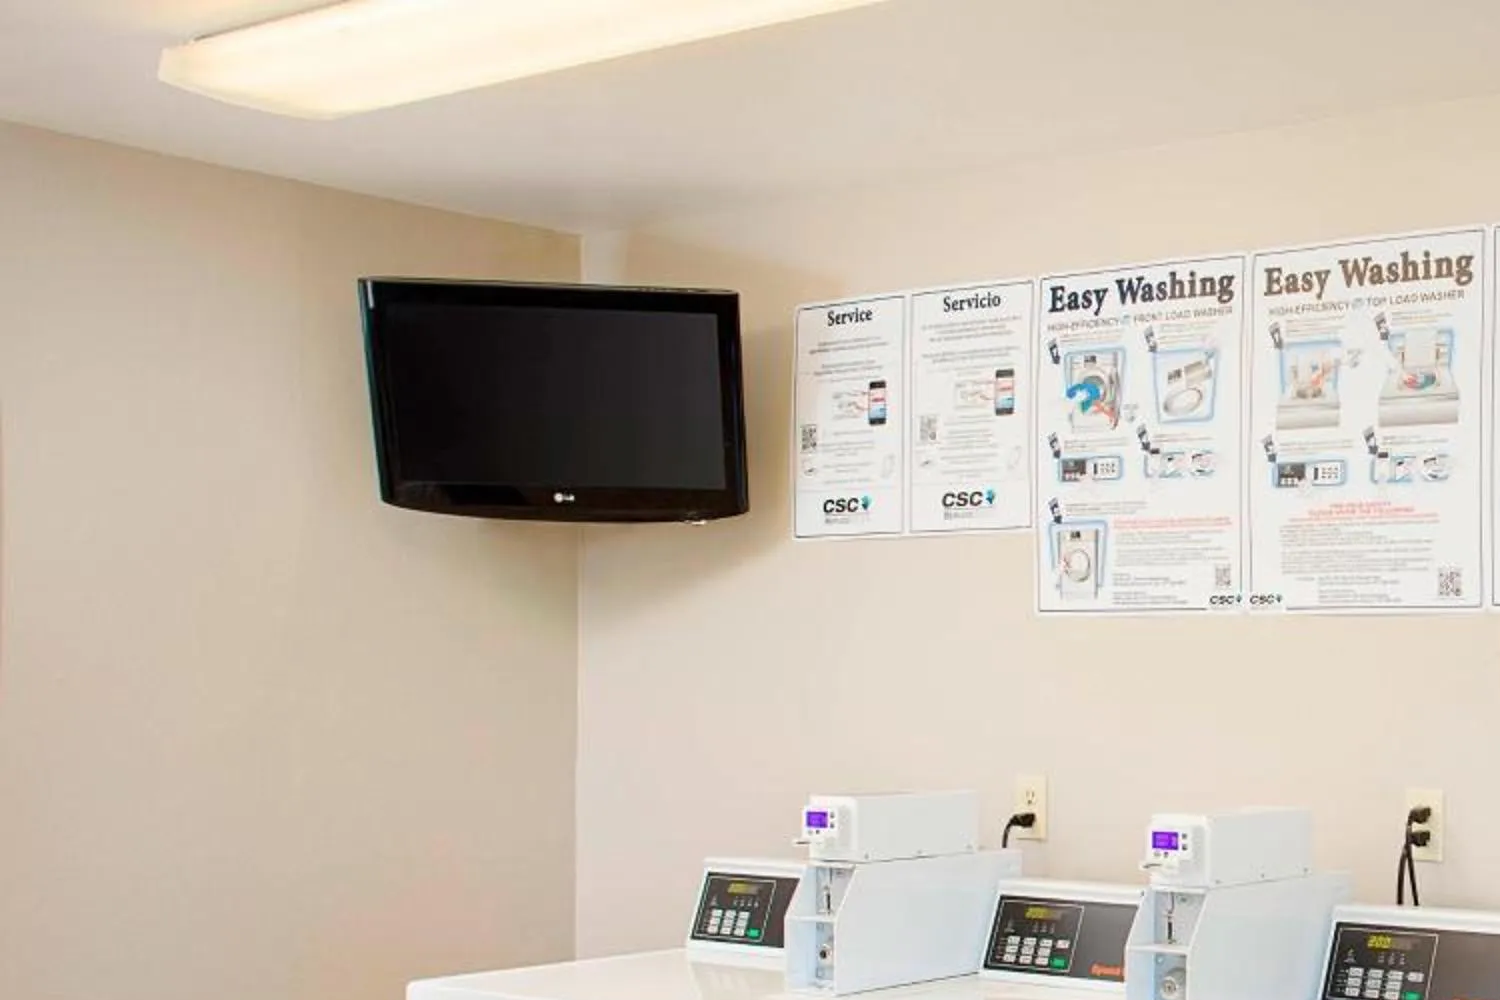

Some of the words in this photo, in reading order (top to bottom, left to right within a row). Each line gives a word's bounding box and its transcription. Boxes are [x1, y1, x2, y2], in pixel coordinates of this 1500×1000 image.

[1263, 266, 1332, 300] Easy
[1338, 249, 1476, 289] Washing
[1047, 285, 1109, 316] Easy
[1115, 271, 1236, 305] Washing
[1420, 289, 1466, 303] WASHER
[943, 292, 1002, 313] Servicio
[827, 307, 874, 327] Service
[823, 497, 860, 514] CSC
[941, 491, 983, 507] CSC
[1209, 595, 1235, 605] CSC
[1249, 594, 1275, 605] CSC
